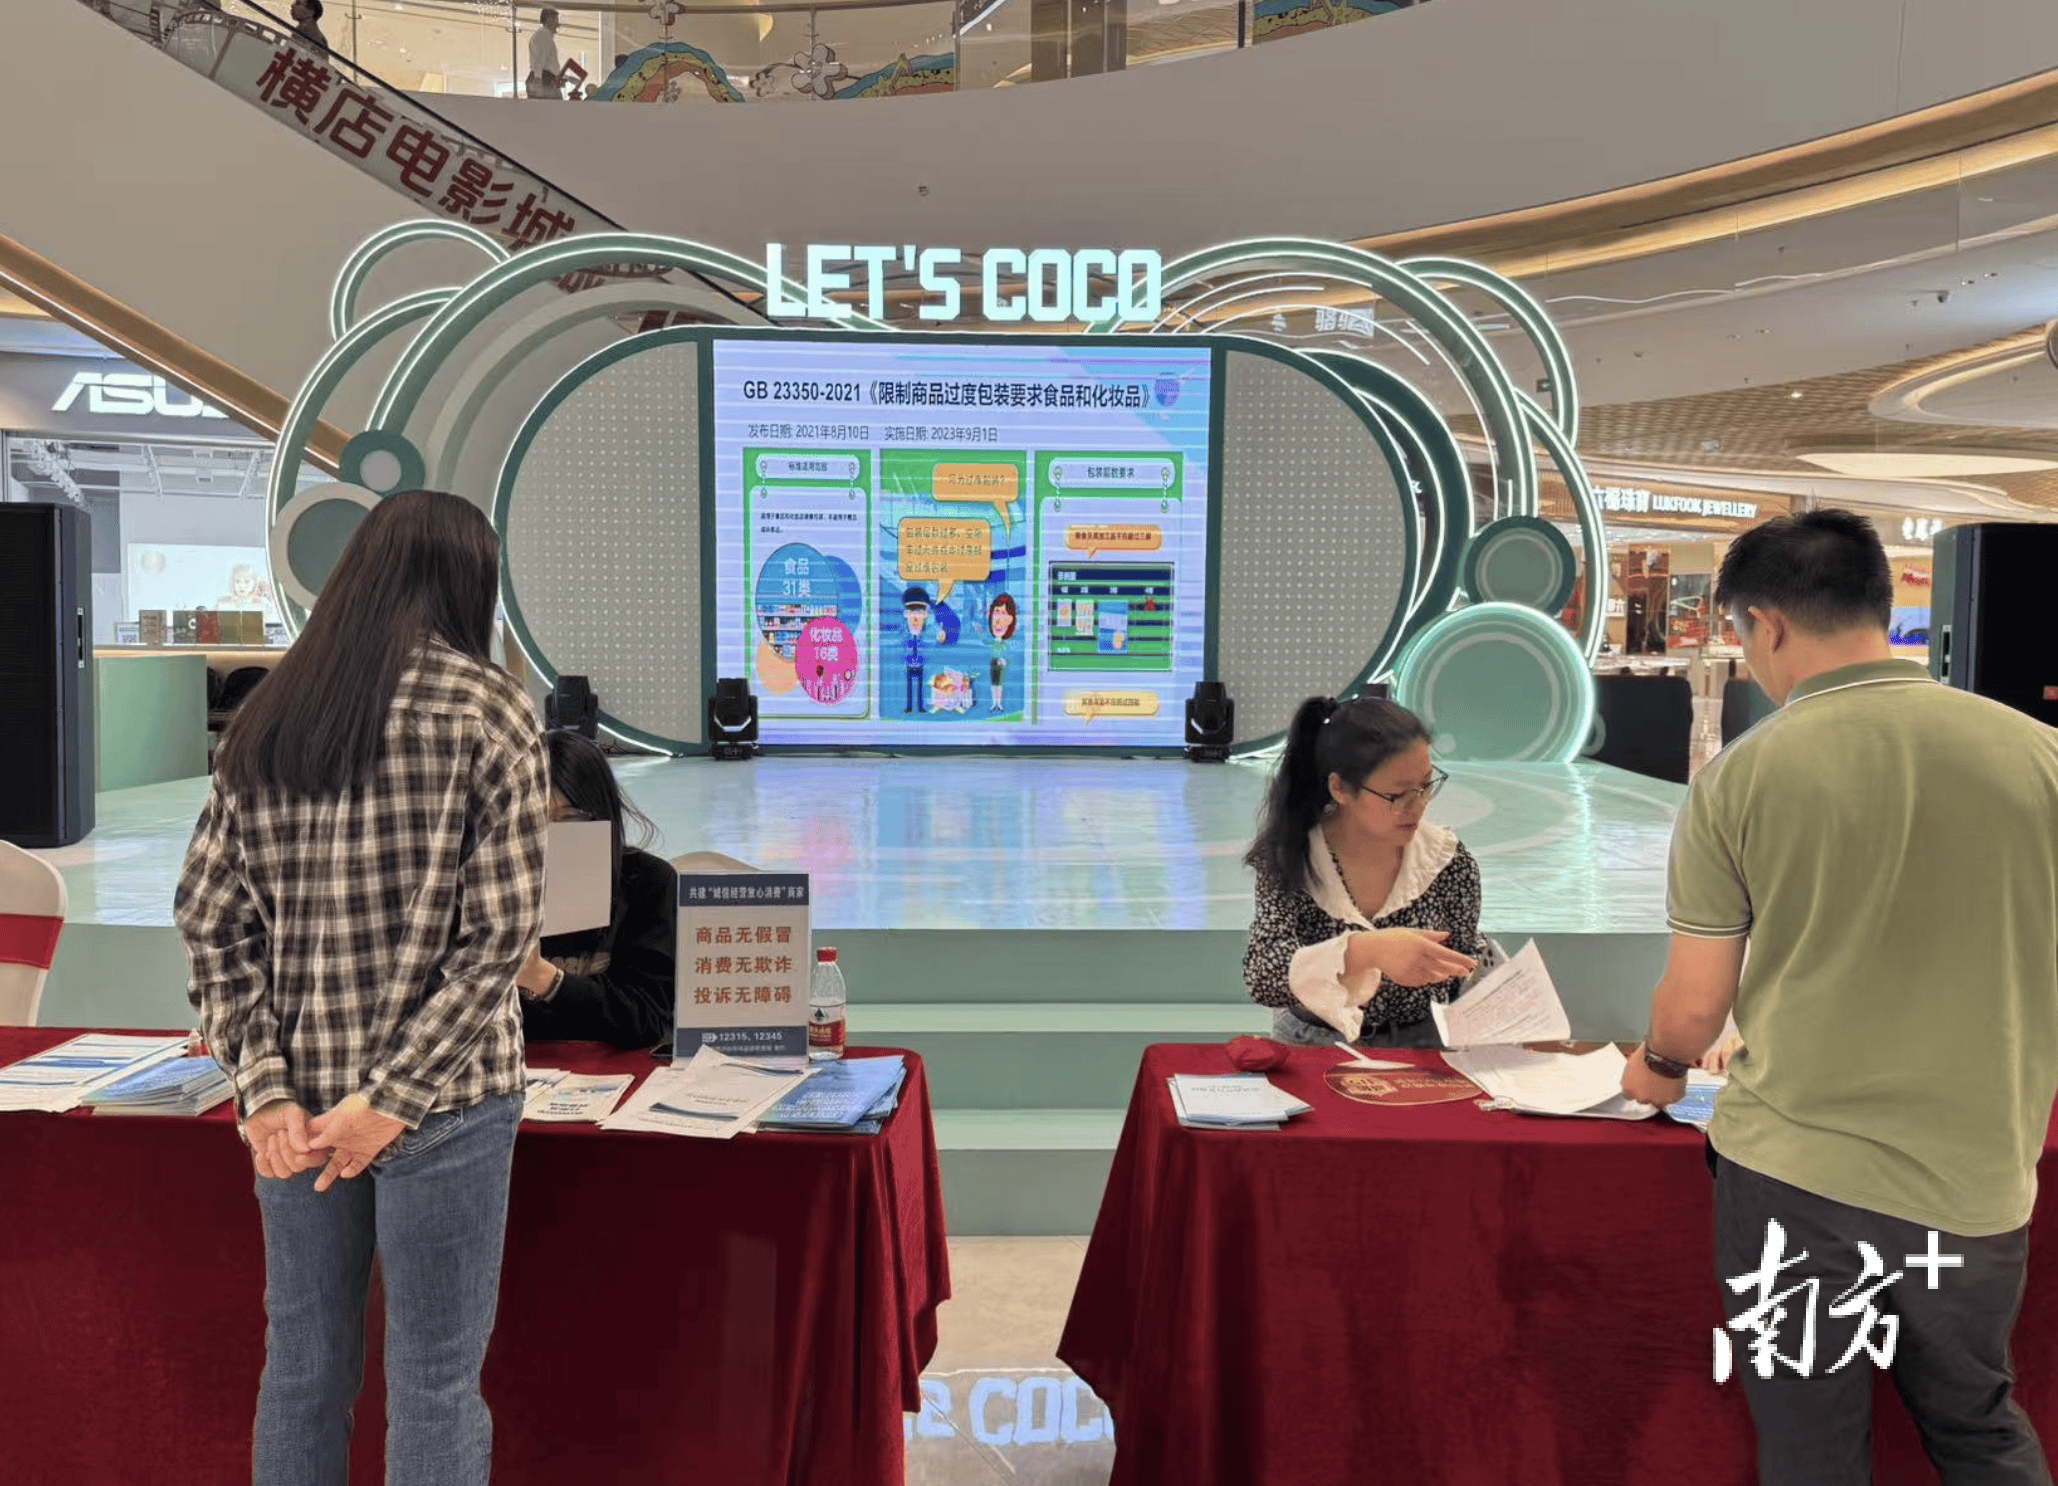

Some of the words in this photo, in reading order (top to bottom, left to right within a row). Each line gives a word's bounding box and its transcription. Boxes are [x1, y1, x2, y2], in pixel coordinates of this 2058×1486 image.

[255, 49, 576, 251] 横店电影城
[765, 242, 961, 322] LET'S
[983, 248, 1163, 323] COCO
[51, 371, 230, 419] ASU
[743, 381, 769, 400] GB
[783, 556, 810, 576] 食品
[782, 579, 811, 598] 31类
[695, 926, 792, 944] 商品无假冒
[694, 956, 793, 974] 消费无欺诈
[693, 986, 792, 1005] 投诉无障碍
